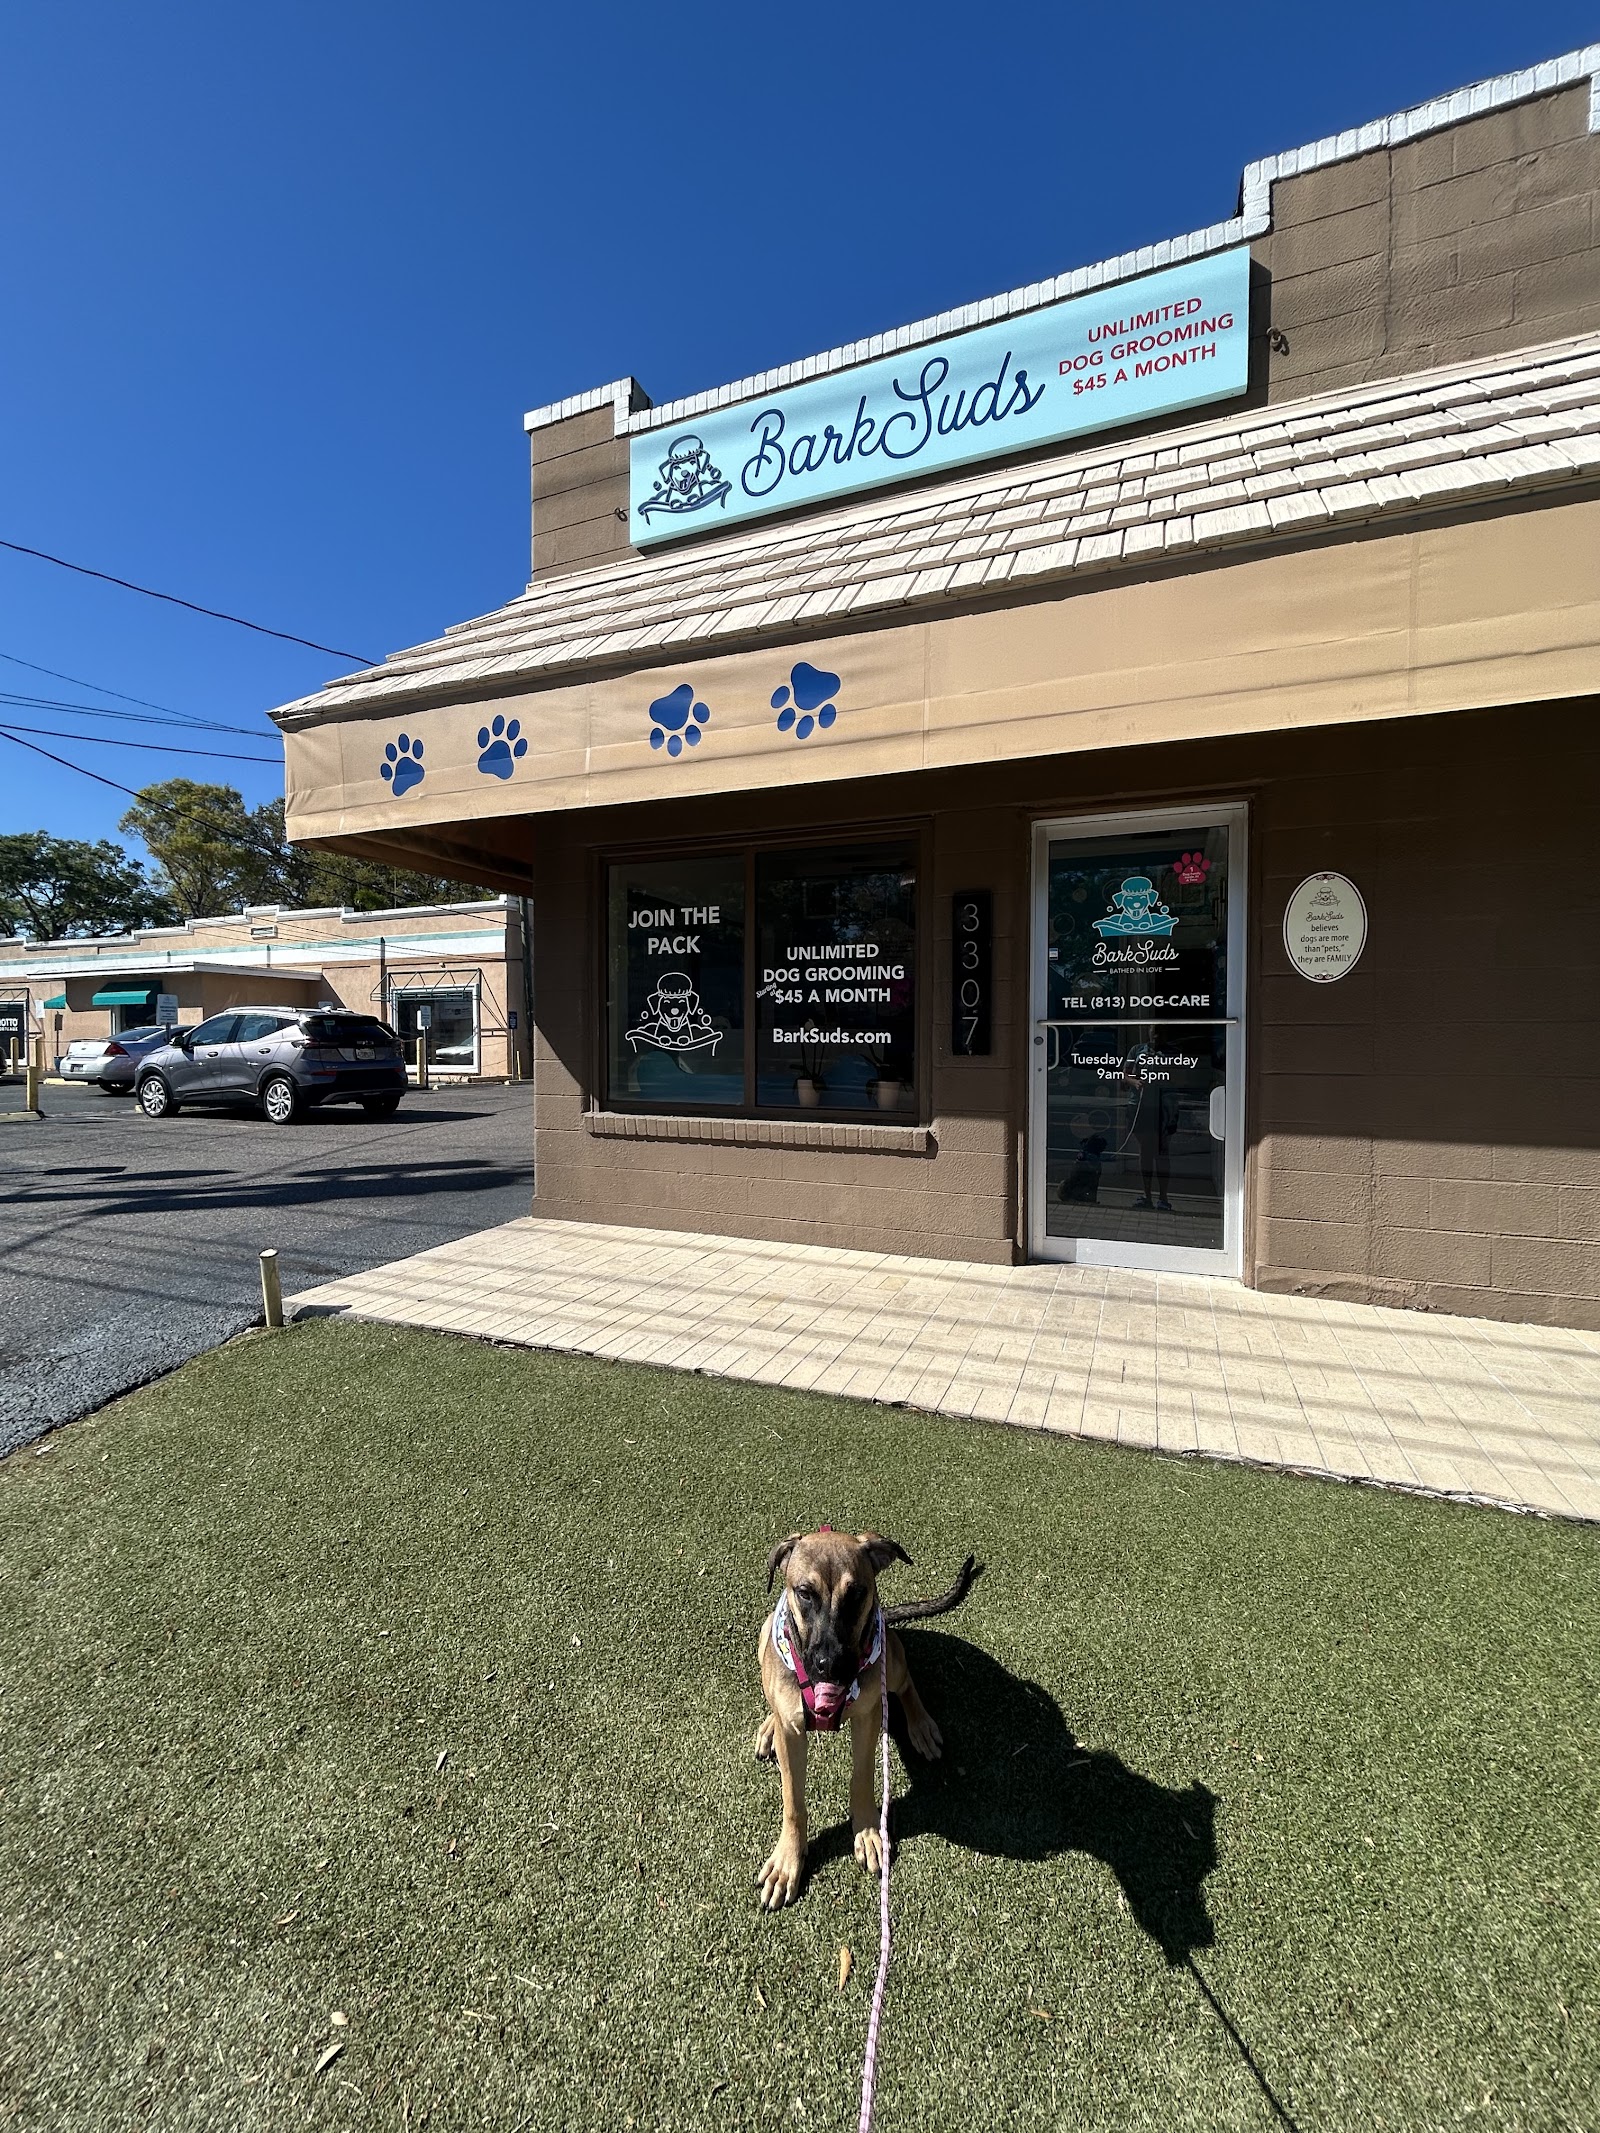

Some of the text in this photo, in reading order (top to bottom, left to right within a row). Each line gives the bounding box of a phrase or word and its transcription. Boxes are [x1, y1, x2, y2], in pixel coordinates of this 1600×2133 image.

[1088, 297, 1202, 343] UNLIMITED
[1059, 313, 1234, 375] DOG GROOMING
[1073, 342, 1216, 395] $45 A MONTH
[742, 351, 1045, 496] BarkSuds
[628, 905, 720, 929] JOIN THE
[648, 935, 701, 955] PACK
[1300, 935, 1317, 944] dogs
[787, 944, 879, 960] UNLIMITED
[1092, 940, 1179, 965] BarkSuds
[1298, 956, 1313, 964] they
[1327, 954, 1352, 962] FAMILY
[763, 965, 905, 982] DOG GROOMING
[961, 903, 979, 1046] 3307
[775, 988, 891, 1004] $45 A MONTH
[1062, 995, 1210, 1009] TEL (813) DOG-CARE
[773, 1027, 892, 1043] BarkSuds.com
[1071, 1053, 1123, 1067] Tuesday
[1138, 1053, 1198, 1069] Saturday
[1097, 1068, 1124, 1080] 9am
[1140, 1069, 1170, 1083] 5pm
